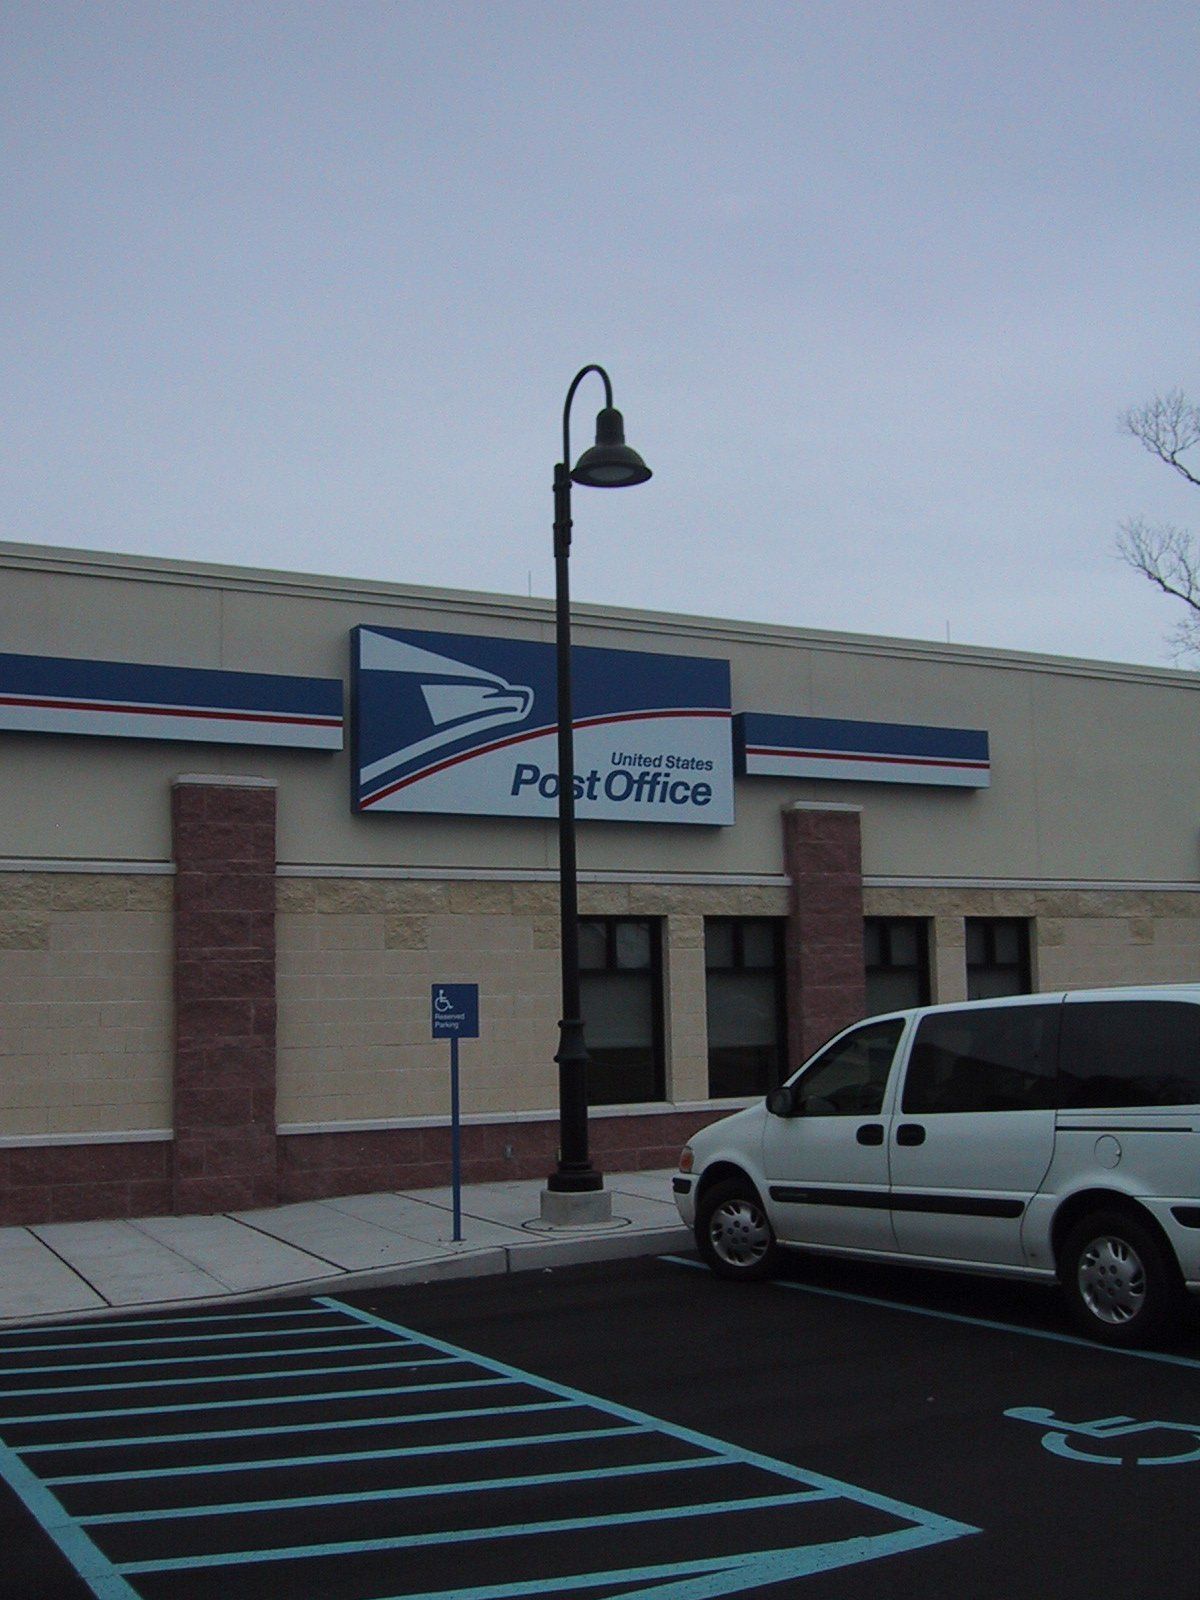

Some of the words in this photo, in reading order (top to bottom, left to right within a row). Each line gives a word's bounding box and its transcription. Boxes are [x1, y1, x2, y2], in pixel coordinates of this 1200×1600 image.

[611, 751, 663, 768] United
[665, 754, 713, 771] States
[511, 763, 601, 800] Post
[604, 769, 712, 806] Office
[434, 1021, 459, 1030] Parking
